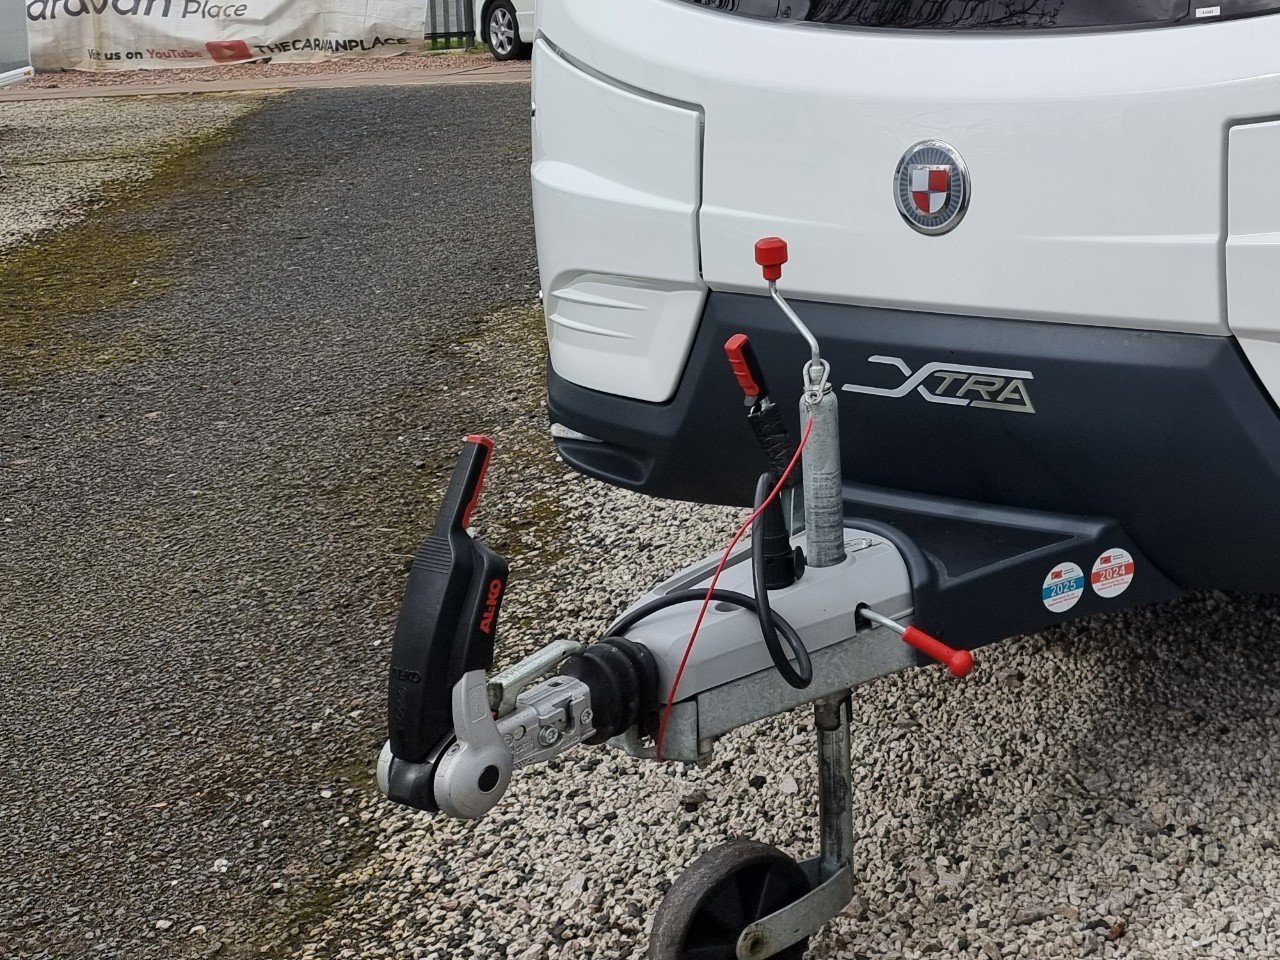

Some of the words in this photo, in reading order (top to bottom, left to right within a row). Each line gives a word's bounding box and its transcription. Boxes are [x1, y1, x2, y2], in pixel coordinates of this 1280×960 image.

[181, 0, 248, 19] Place
[104, 50, 121, 60] us
[126, 49, 143, 60] on
[146, 48, 203, 59] YouTube
[842, 354, 1036, 414] XTRA
[1100, 565, 1126, 581] 2024
[1051, 580, 1077, 597] 2025
